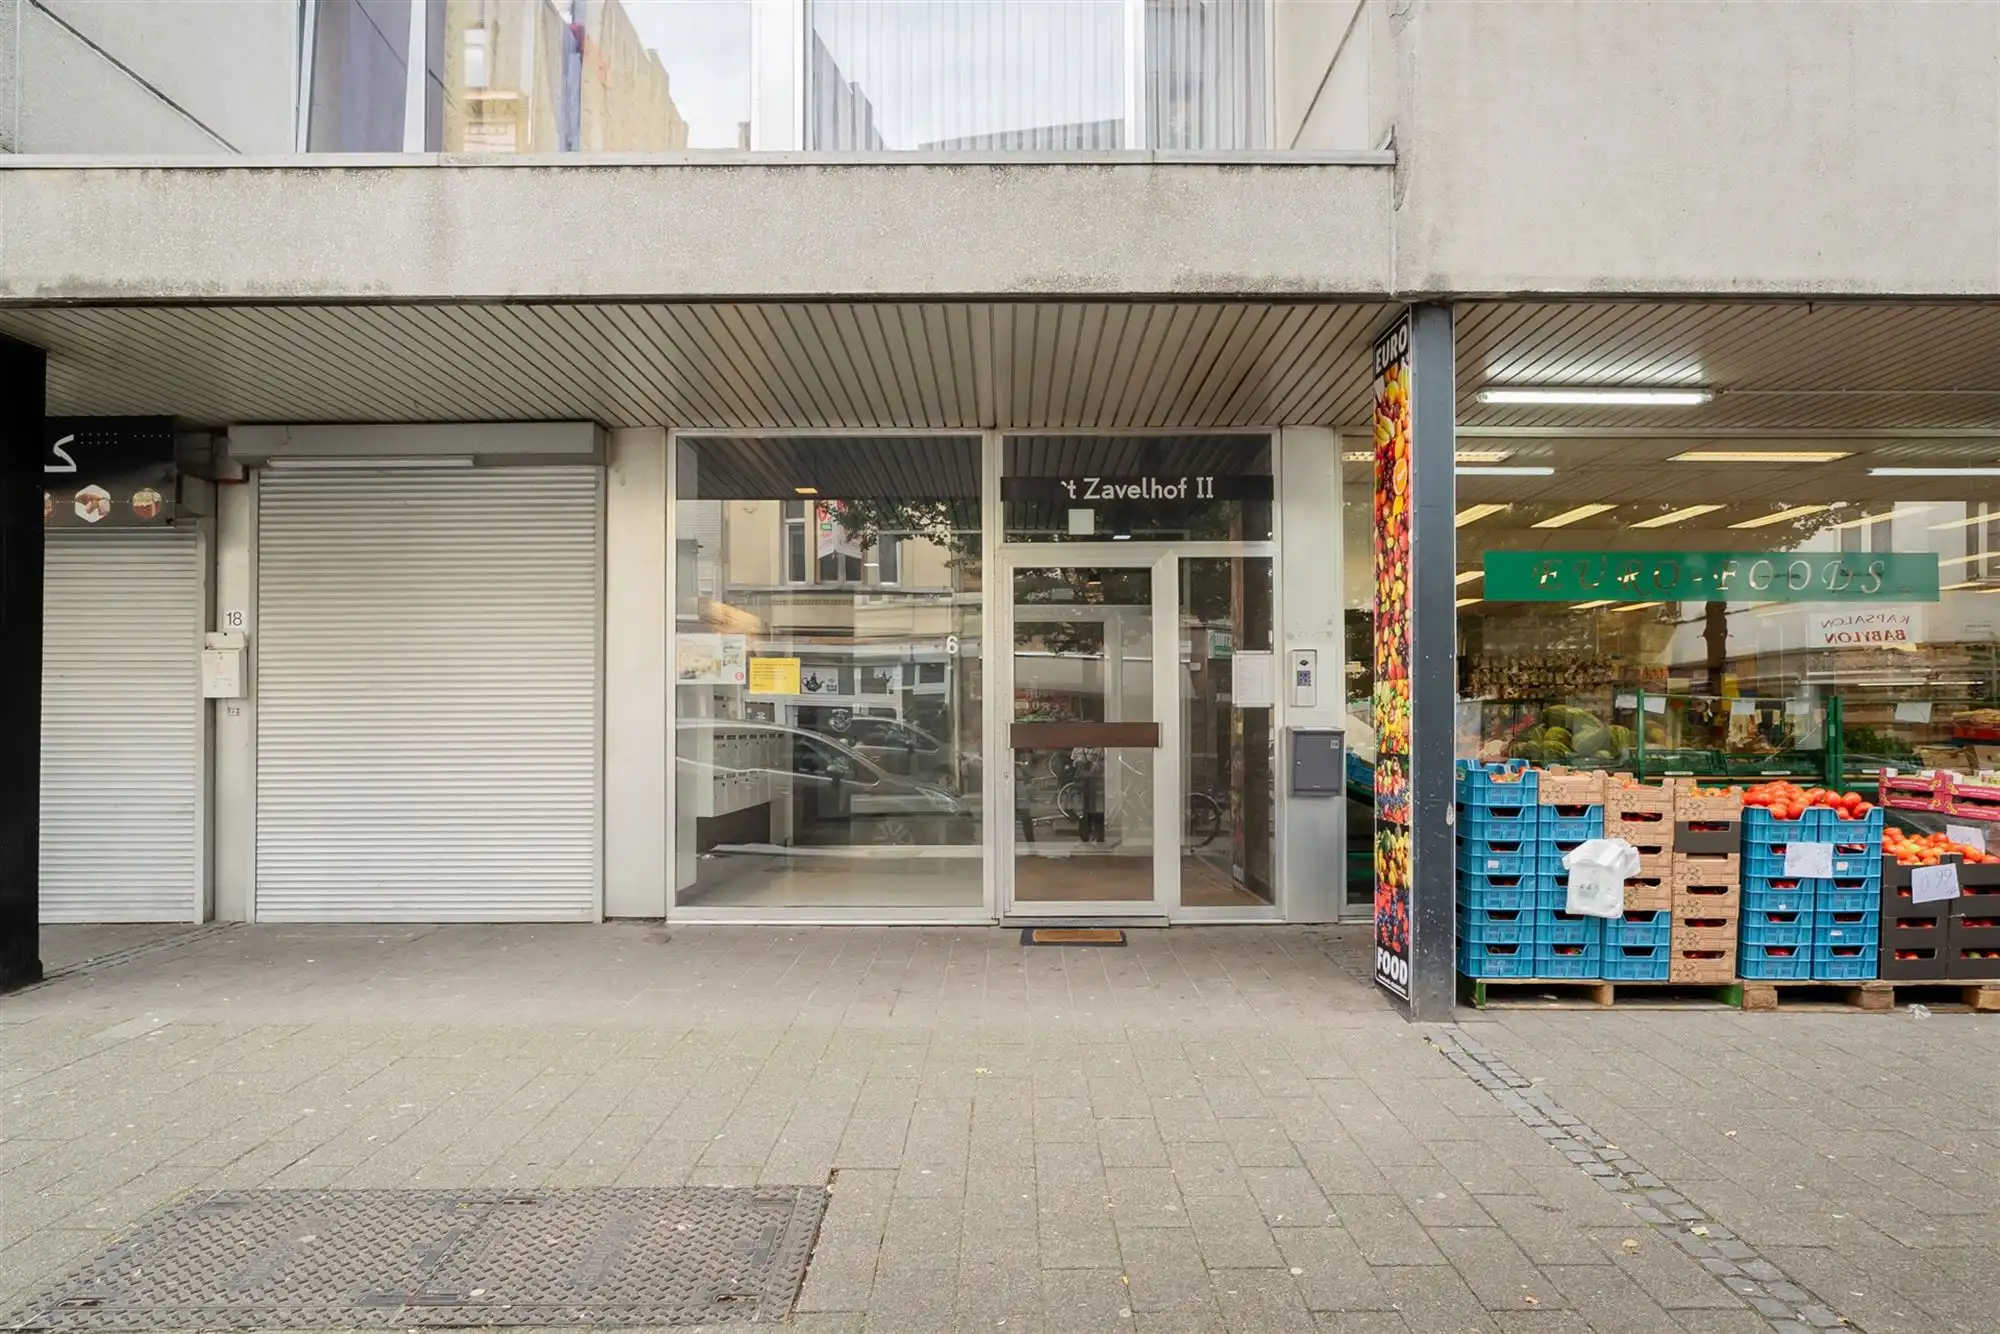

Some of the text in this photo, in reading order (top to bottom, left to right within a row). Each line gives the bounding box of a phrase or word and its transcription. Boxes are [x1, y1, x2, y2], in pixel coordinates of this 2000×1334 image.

[1376, 324, 1408, 374] EURO
[1083, 477, 1188, 500] Zavelhof
[1196, 476, 1214, 499] II
[226, 611, 243, 626] 18
[946, 635, 958, 654] 6
[1377, 946, 1409, 986] FOOD
